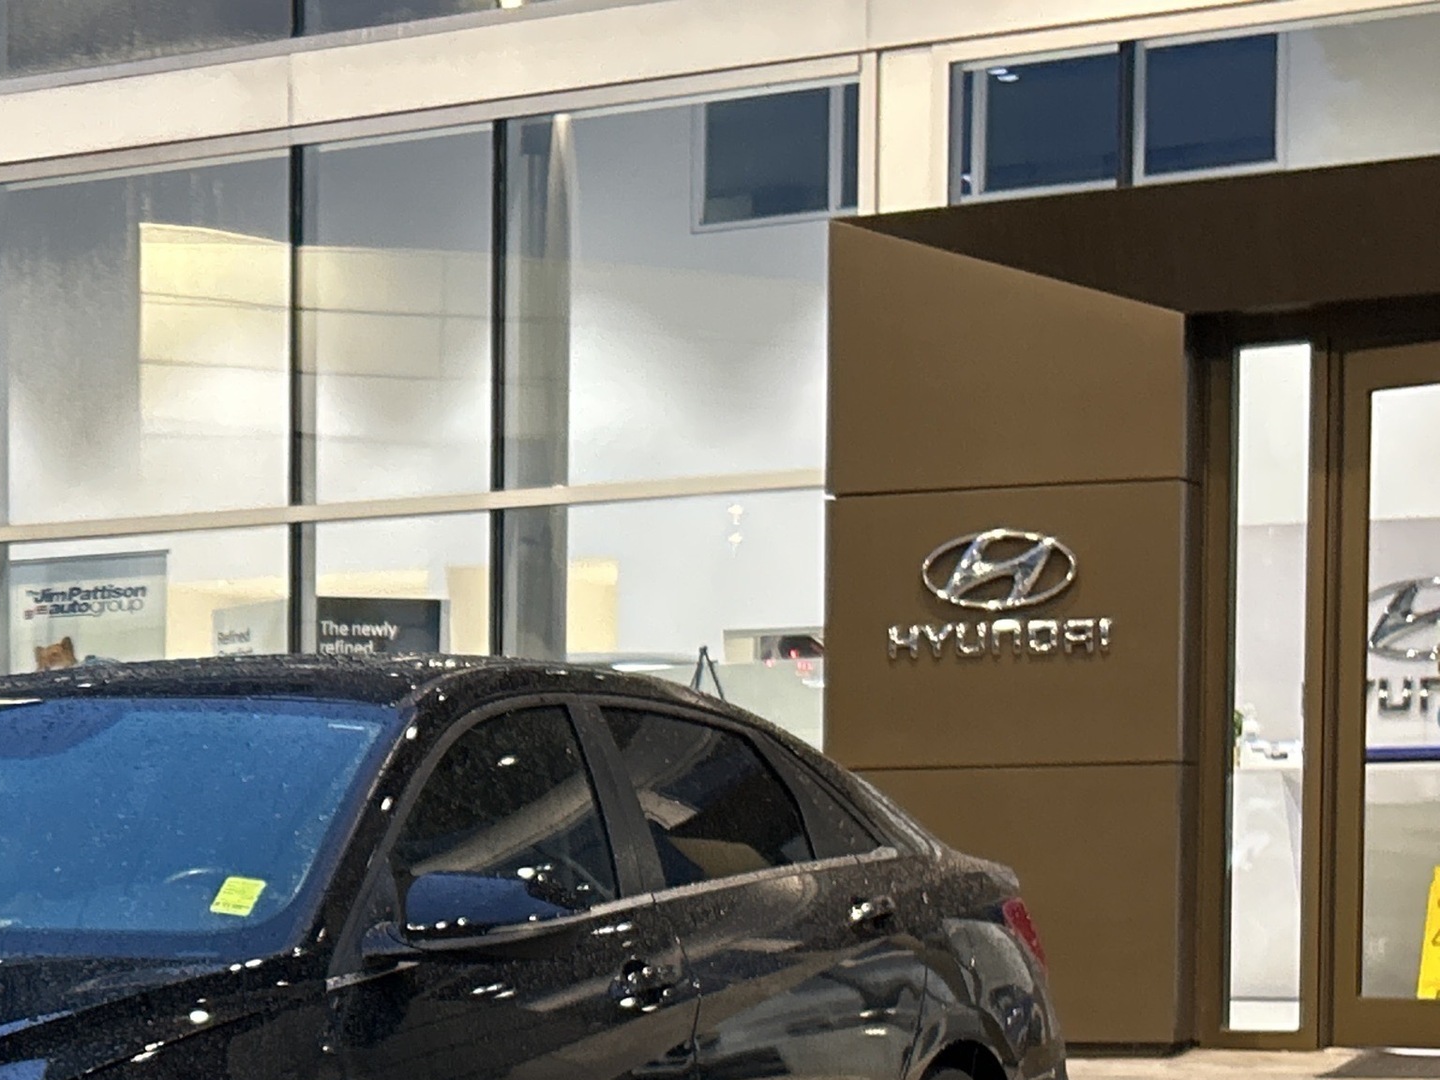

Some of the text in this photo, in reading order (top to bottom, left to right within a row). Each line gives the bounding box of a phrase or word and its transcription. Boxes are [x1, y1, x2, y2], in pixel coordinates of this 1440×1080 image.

[321, 620, 398, 640] The newly
[888, 617, 1111, 659] HYUNDAI
